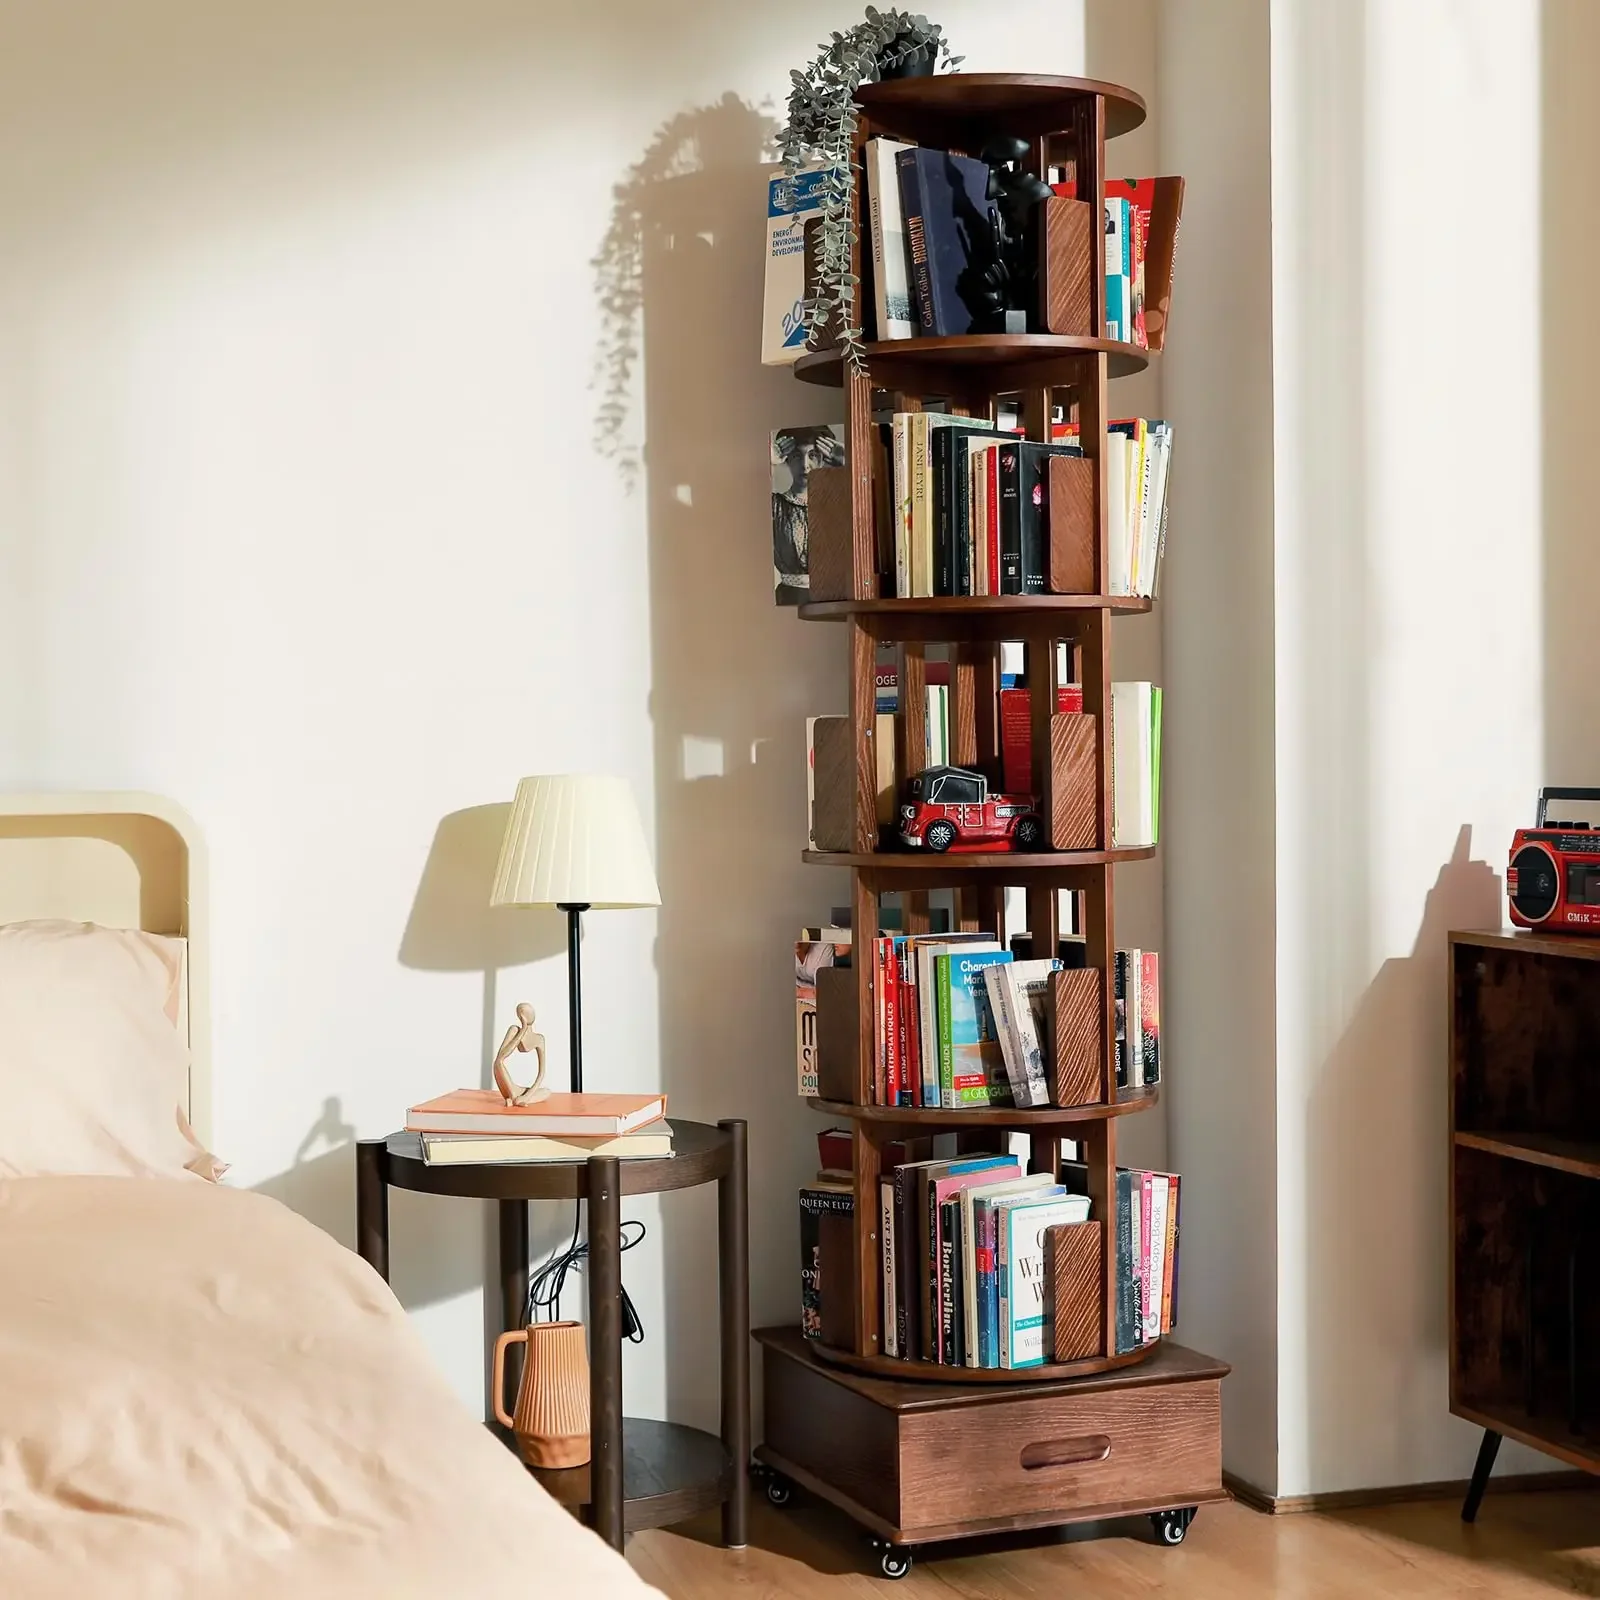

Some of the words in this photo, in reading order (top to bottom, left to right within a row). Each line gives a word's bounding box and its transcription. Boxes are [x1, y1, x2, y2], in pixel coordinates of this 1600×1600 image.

[772, 228, 793, 239] ENERGY
[908, 216, 928, 264] BROOKLYN
[922, 301, 934, 328] Colm
[1567, 913, 1589, 922] CMiK
[1114, 1042, 1122, 1072] ANDRÉ
[800, 1197, 830, 1209] QUEEN
[942, 1241, 953, 1335] Borderline
[1142, 1255, 1152, 1304] cupcakes
[1150, 1276, 1158, 1297] The
[1131, 1281, 1143, 1328] Switched
